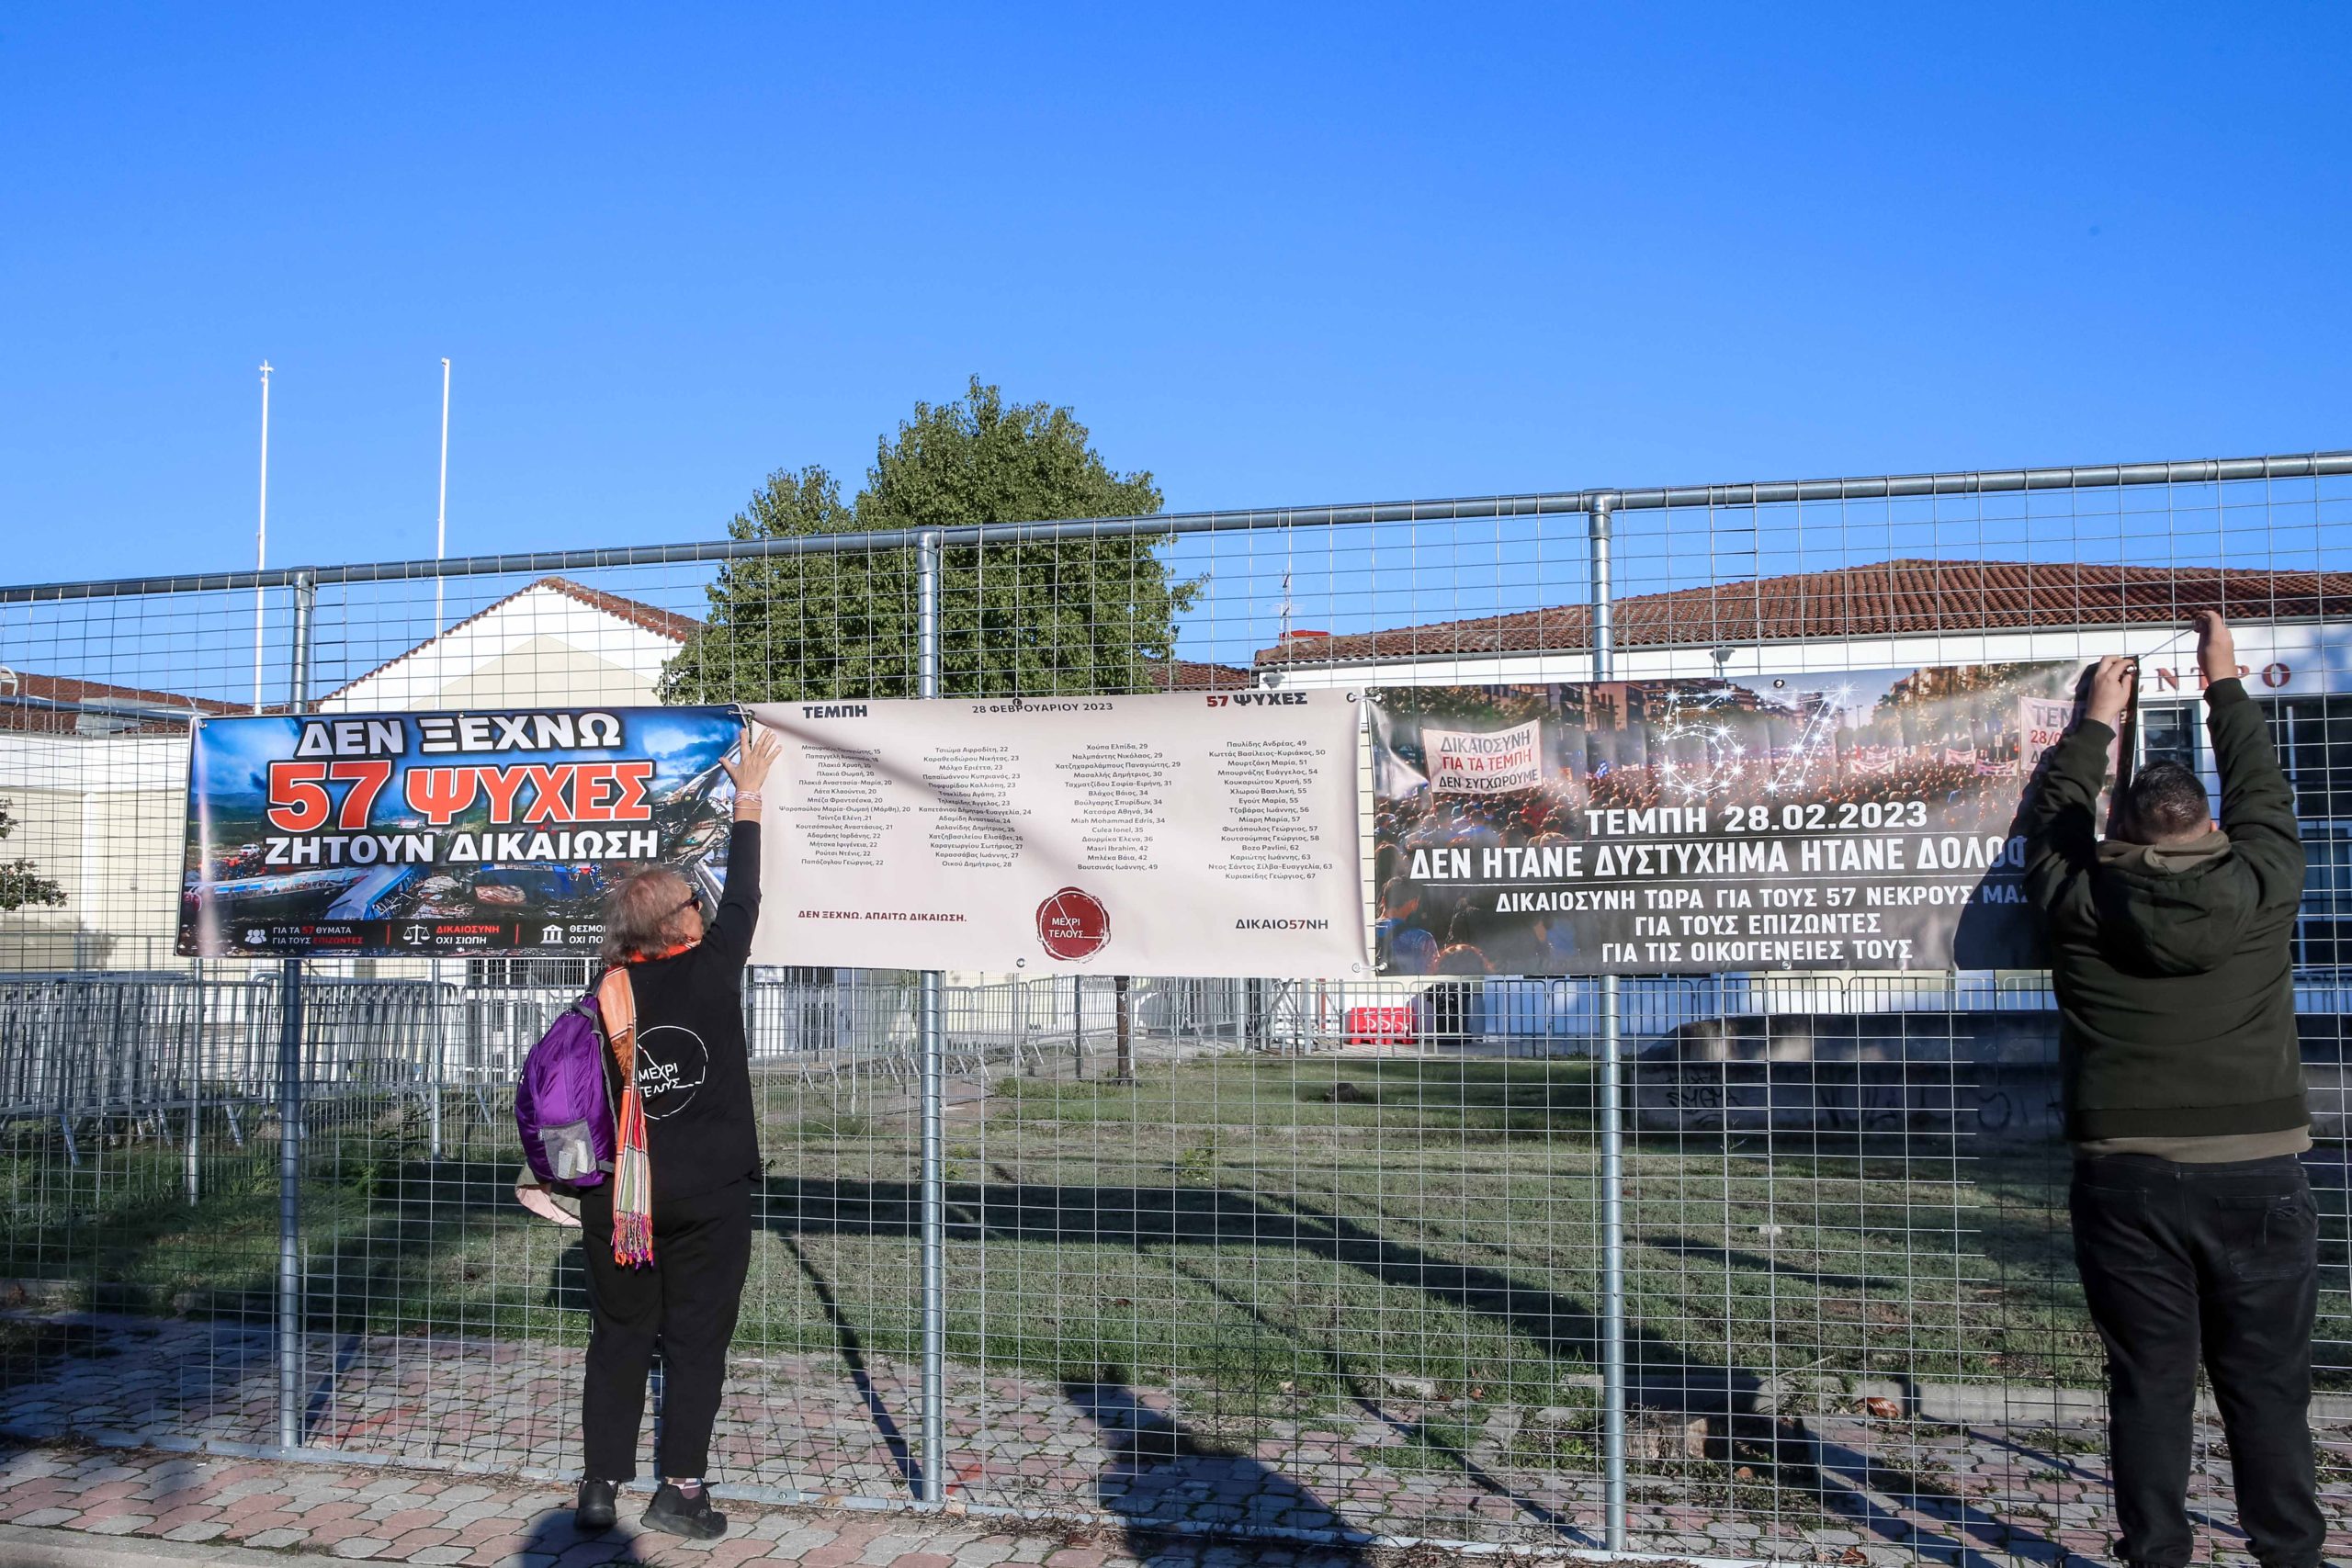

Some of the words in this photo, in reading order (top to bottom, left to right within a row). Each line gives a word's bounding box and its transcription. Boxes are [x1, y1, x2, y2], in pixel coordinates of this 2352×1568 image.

[972, 705, 987, 714] 28
[989, 703, 1079, 714] ΦΕΒΡΟΥΑΡΙΟΥ
[1083, 702, 1114, 712] 2023
[1206, 695, 1228, 707] 57
[1233, 693, 1307, 705] ΨΥΧΕΣ
[803, 705, 867, 718] ΤΕΜΠΗ
[296, 721, 403, 757] ΔΕΝ
[421, 714, 621, 751] ΞΕΧΝΩ
[1441, 729, 1531, 753] ΔΙΚΑΙΟΣΥΝΗ
[1442, 756, 1464, 771] ΓΙΑ
[1467, 757, 1484, 771] ΤΑ
[1488, 749, 1532, 771] ΤΕΜΠΗ
[1440, 776, 1461, 788] ΔΕΝ
[1465, 769, 1538, 789] ΣΥΓΧΩΡΟΥΜΕ
[267, 761, 391, 831] 57
[406, 761, 653, 824] ΨΥΧΕΣ
[1585, 807, 1707, 836] ΤΕΜΠΗ
[1724, 801, 1928, 832] 28.02.2023
[266, 835, 434, 865] ΖΗΤΟΥΝ
[448, 831, 659, 862] ΔΙΚΑΙΩΣΗ
[1409, 848, 1471, 880] ΔΕΝ
[1483, 844, 1583, 879] ΗΤΑΝΕ
[1594, 840, 1789, 876] ΔΥΣΤΥΧΗΜΑ
[1802, 836, 1905, 871] ΗΤΑΝΕ
[1496, 889, 1635, 913] ΔΙΚΑΙΟΣΥΝΗ
[1645, 888, 1703, 909] ΤΩΡΑ
[1717, 888, 1753, 908] ΓΙΑ
[1759, 887, 1817, 908] ΤΟΥΣ
[1826, 887, 1857, 906] 57
[1867, 886, 1973, 906] ΝΕΚΡΟΥΣ
[797, 910, 820, 919] ΔΕΝ
[821, 911, 862, 919] ΞΕΧΝΩ.
[865, 912, 907, 920] ΑΠΑΙΤΩ
[910, 913, 967, 922] ΔΙΚΑΙΩΣΗ.
[1052, 918, 1080, 926] ΜΕΧΡΙ
[1236, 919, 1329, 930] ΔΙΚΑΙΟ57ΝΗ
[1635, 916, 1672, 936] ΓΙΑ
[1679, 915, 1738, 935] ΤΟΥΣ
[1748, 913, 1882, 935] ΕΠΙΖΩΝΤΕΣ
[302, 926, 314, 935] 57
[1048, 930, 1084, 938] ΤΕΛΟΥΣ
[1602, 942, 1638, 963] ΓΙΑ
[1644, 942, 1681, 963] ΤΙΣ
[1691, 940, 1844, 962] ΟΙΚΟΓΕΝΕΙΕΣ
[1853, 939, 1913, 960] ΤΟΥΣ
[639, 1063, 678, 1082] ΜΕΧΡΙ
